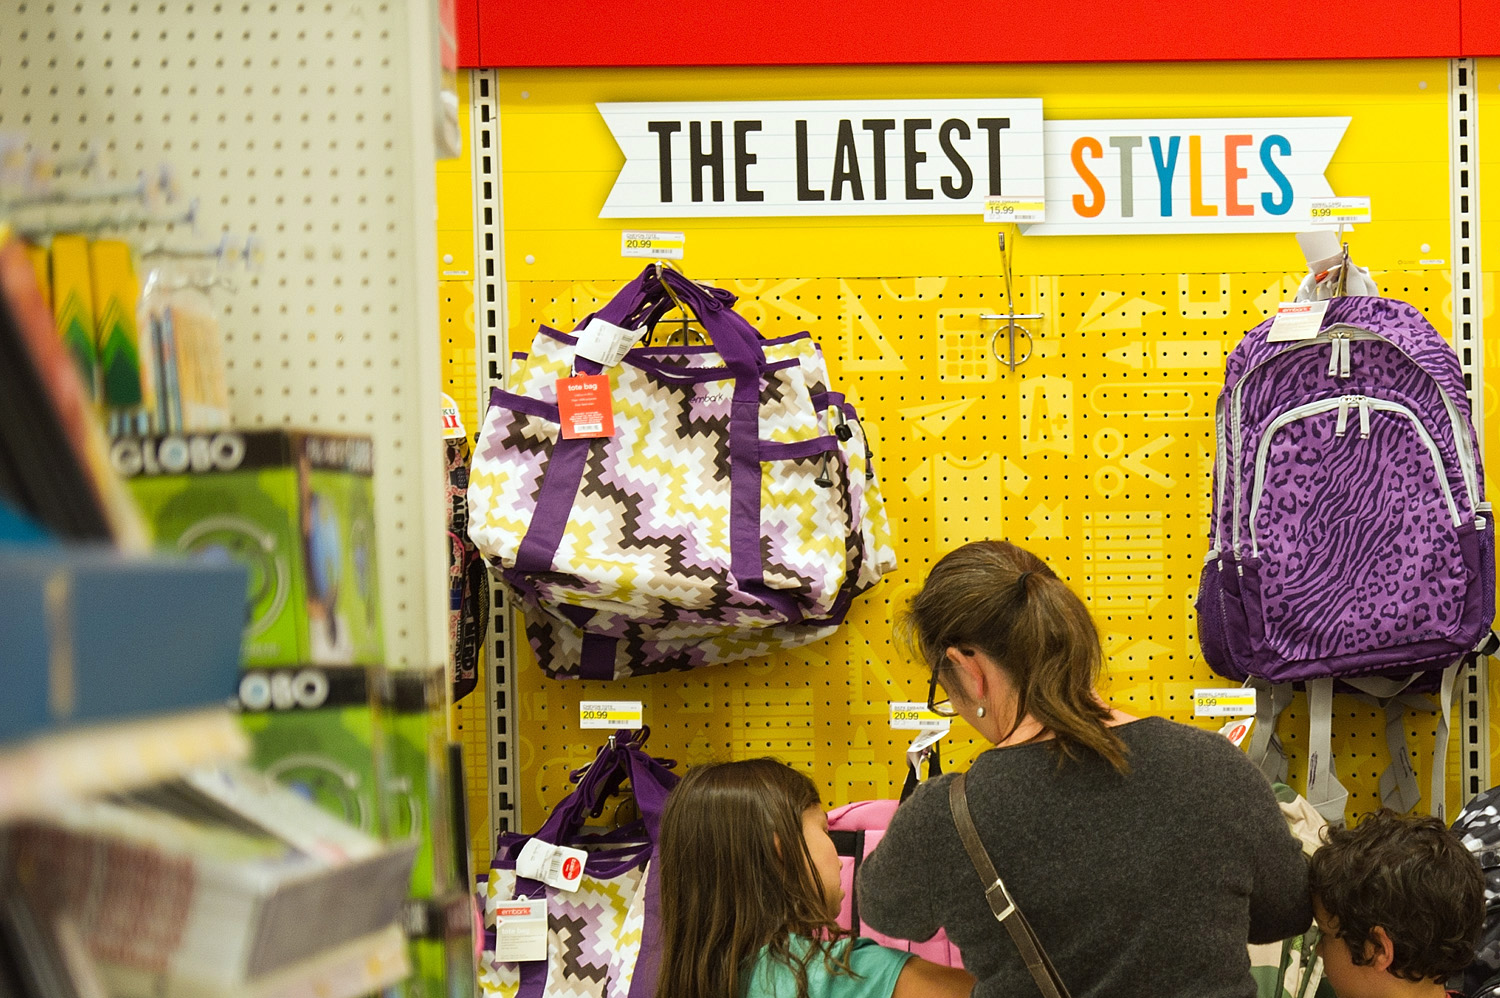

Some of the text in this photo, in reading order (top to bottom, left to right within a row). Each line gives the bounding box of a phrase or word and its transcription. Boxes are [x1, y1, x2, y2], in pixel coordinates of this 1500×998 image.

[647, 117, 1295, 219] THE LATEST STYLES
[990, 206, 1014, 214] 15.99
[1312, 208, 1332, 217] 9.99
[626, 240, 652, 248] 20.99
[568, 382, 598, 392] tote bag
[690, 393, 723, 404] embark
[1198, 698, 1217, 706] 9.99
[583, 711, 608, 720] 20.99
[894, 712, 918, 720] 20.99
